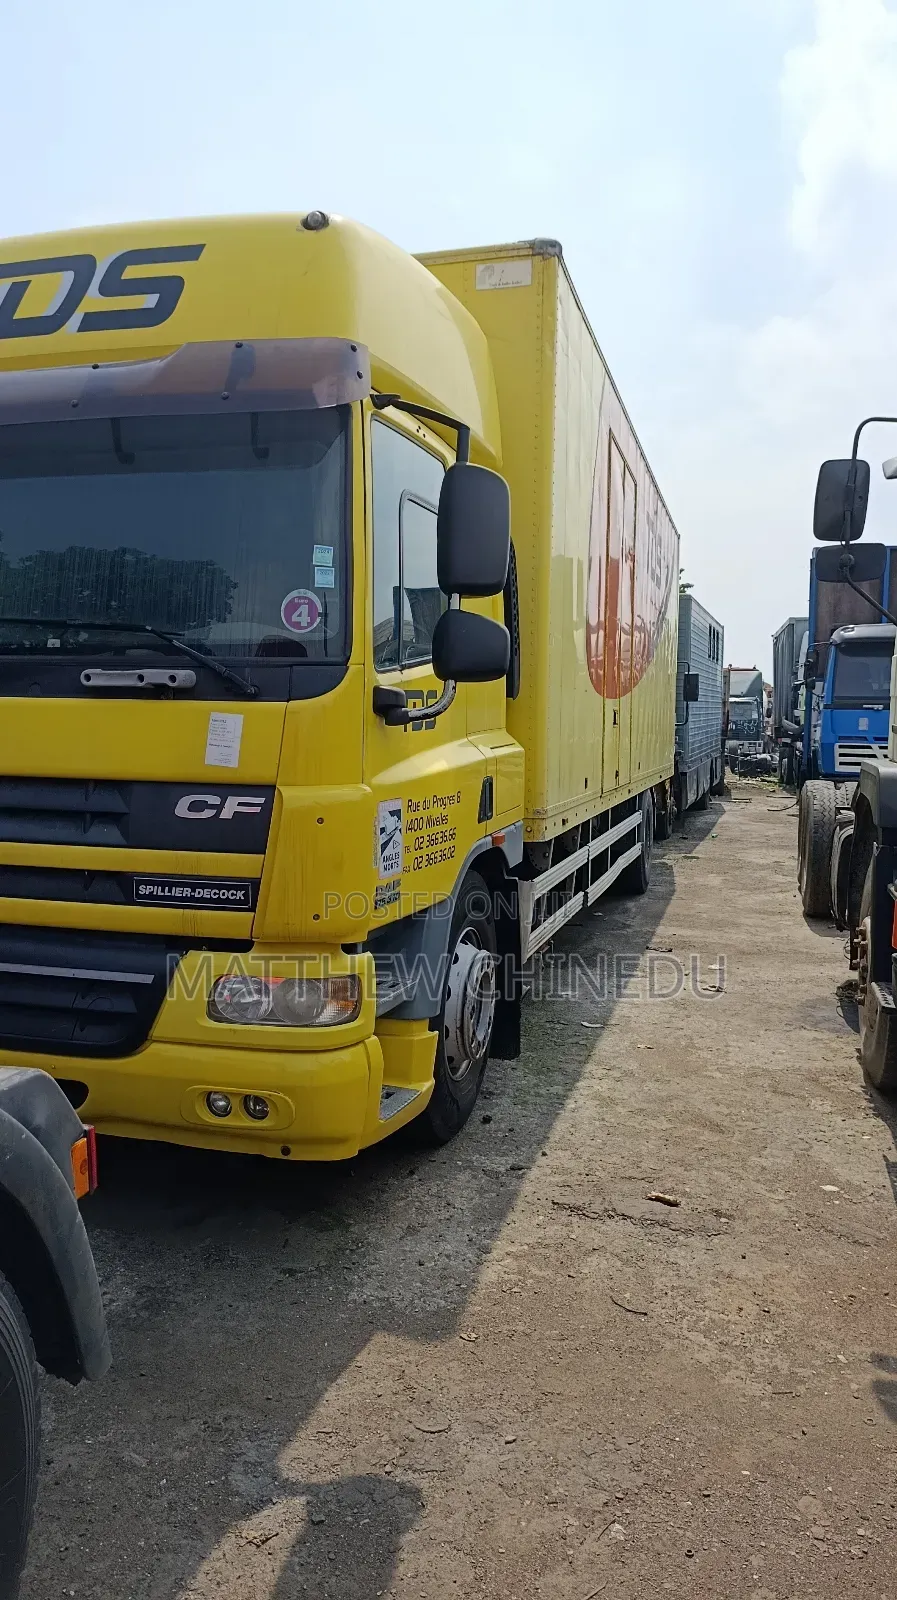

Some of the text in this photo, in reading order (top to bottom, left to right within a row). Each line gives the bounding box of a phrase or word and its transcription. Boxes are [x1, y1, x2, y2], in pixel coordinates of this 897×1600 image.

[0, 243, 207, 340] DS
[291, 604, 311, 627] 4
[174, 794, 266, 819] CF
[407, 798, 421, 813] Rue
[422, 796, 431, 811] du
[405, 816, 424, 834] 1400
[413, 836, 425, 852] 02
[382, 851, 400, 863] ANGLES
[412, 855, 424, 872] 02
[383, 860, 399, 872] MORTS
[138, 884, 246, 901] SPILLIER-DECOCK
